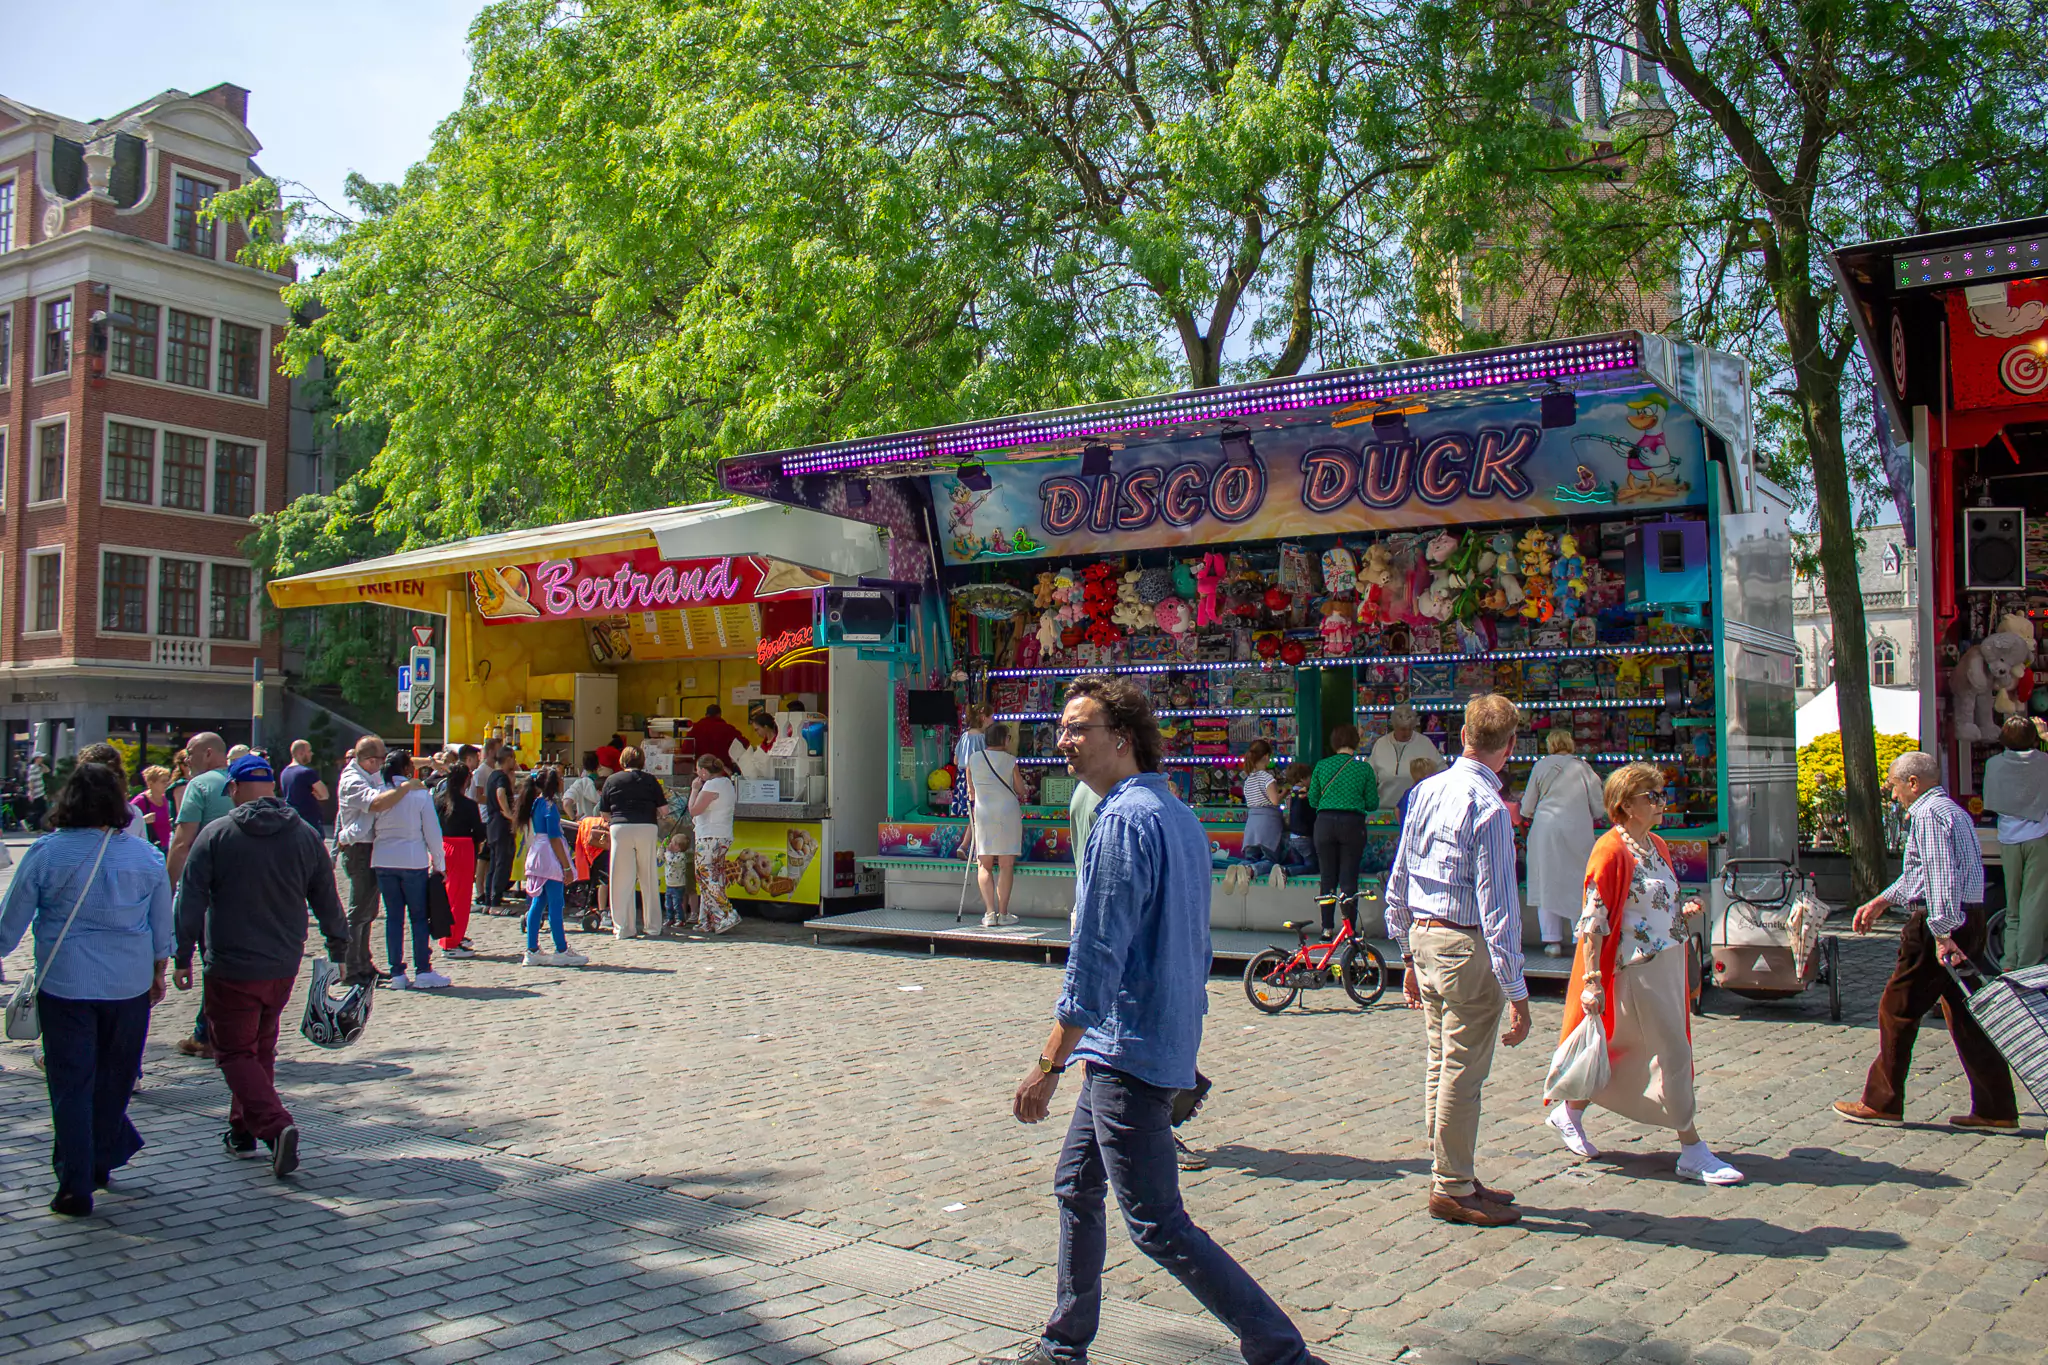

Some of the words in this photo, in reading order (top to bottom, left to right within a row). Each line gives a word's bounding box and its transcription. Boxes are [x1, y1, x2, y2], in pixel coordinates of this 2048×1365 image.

[1039, 457, 1269, 536] DISCO
[1300, 427, 1543, 513] DUCK
[536, 557, 741, 615] Bertrand
